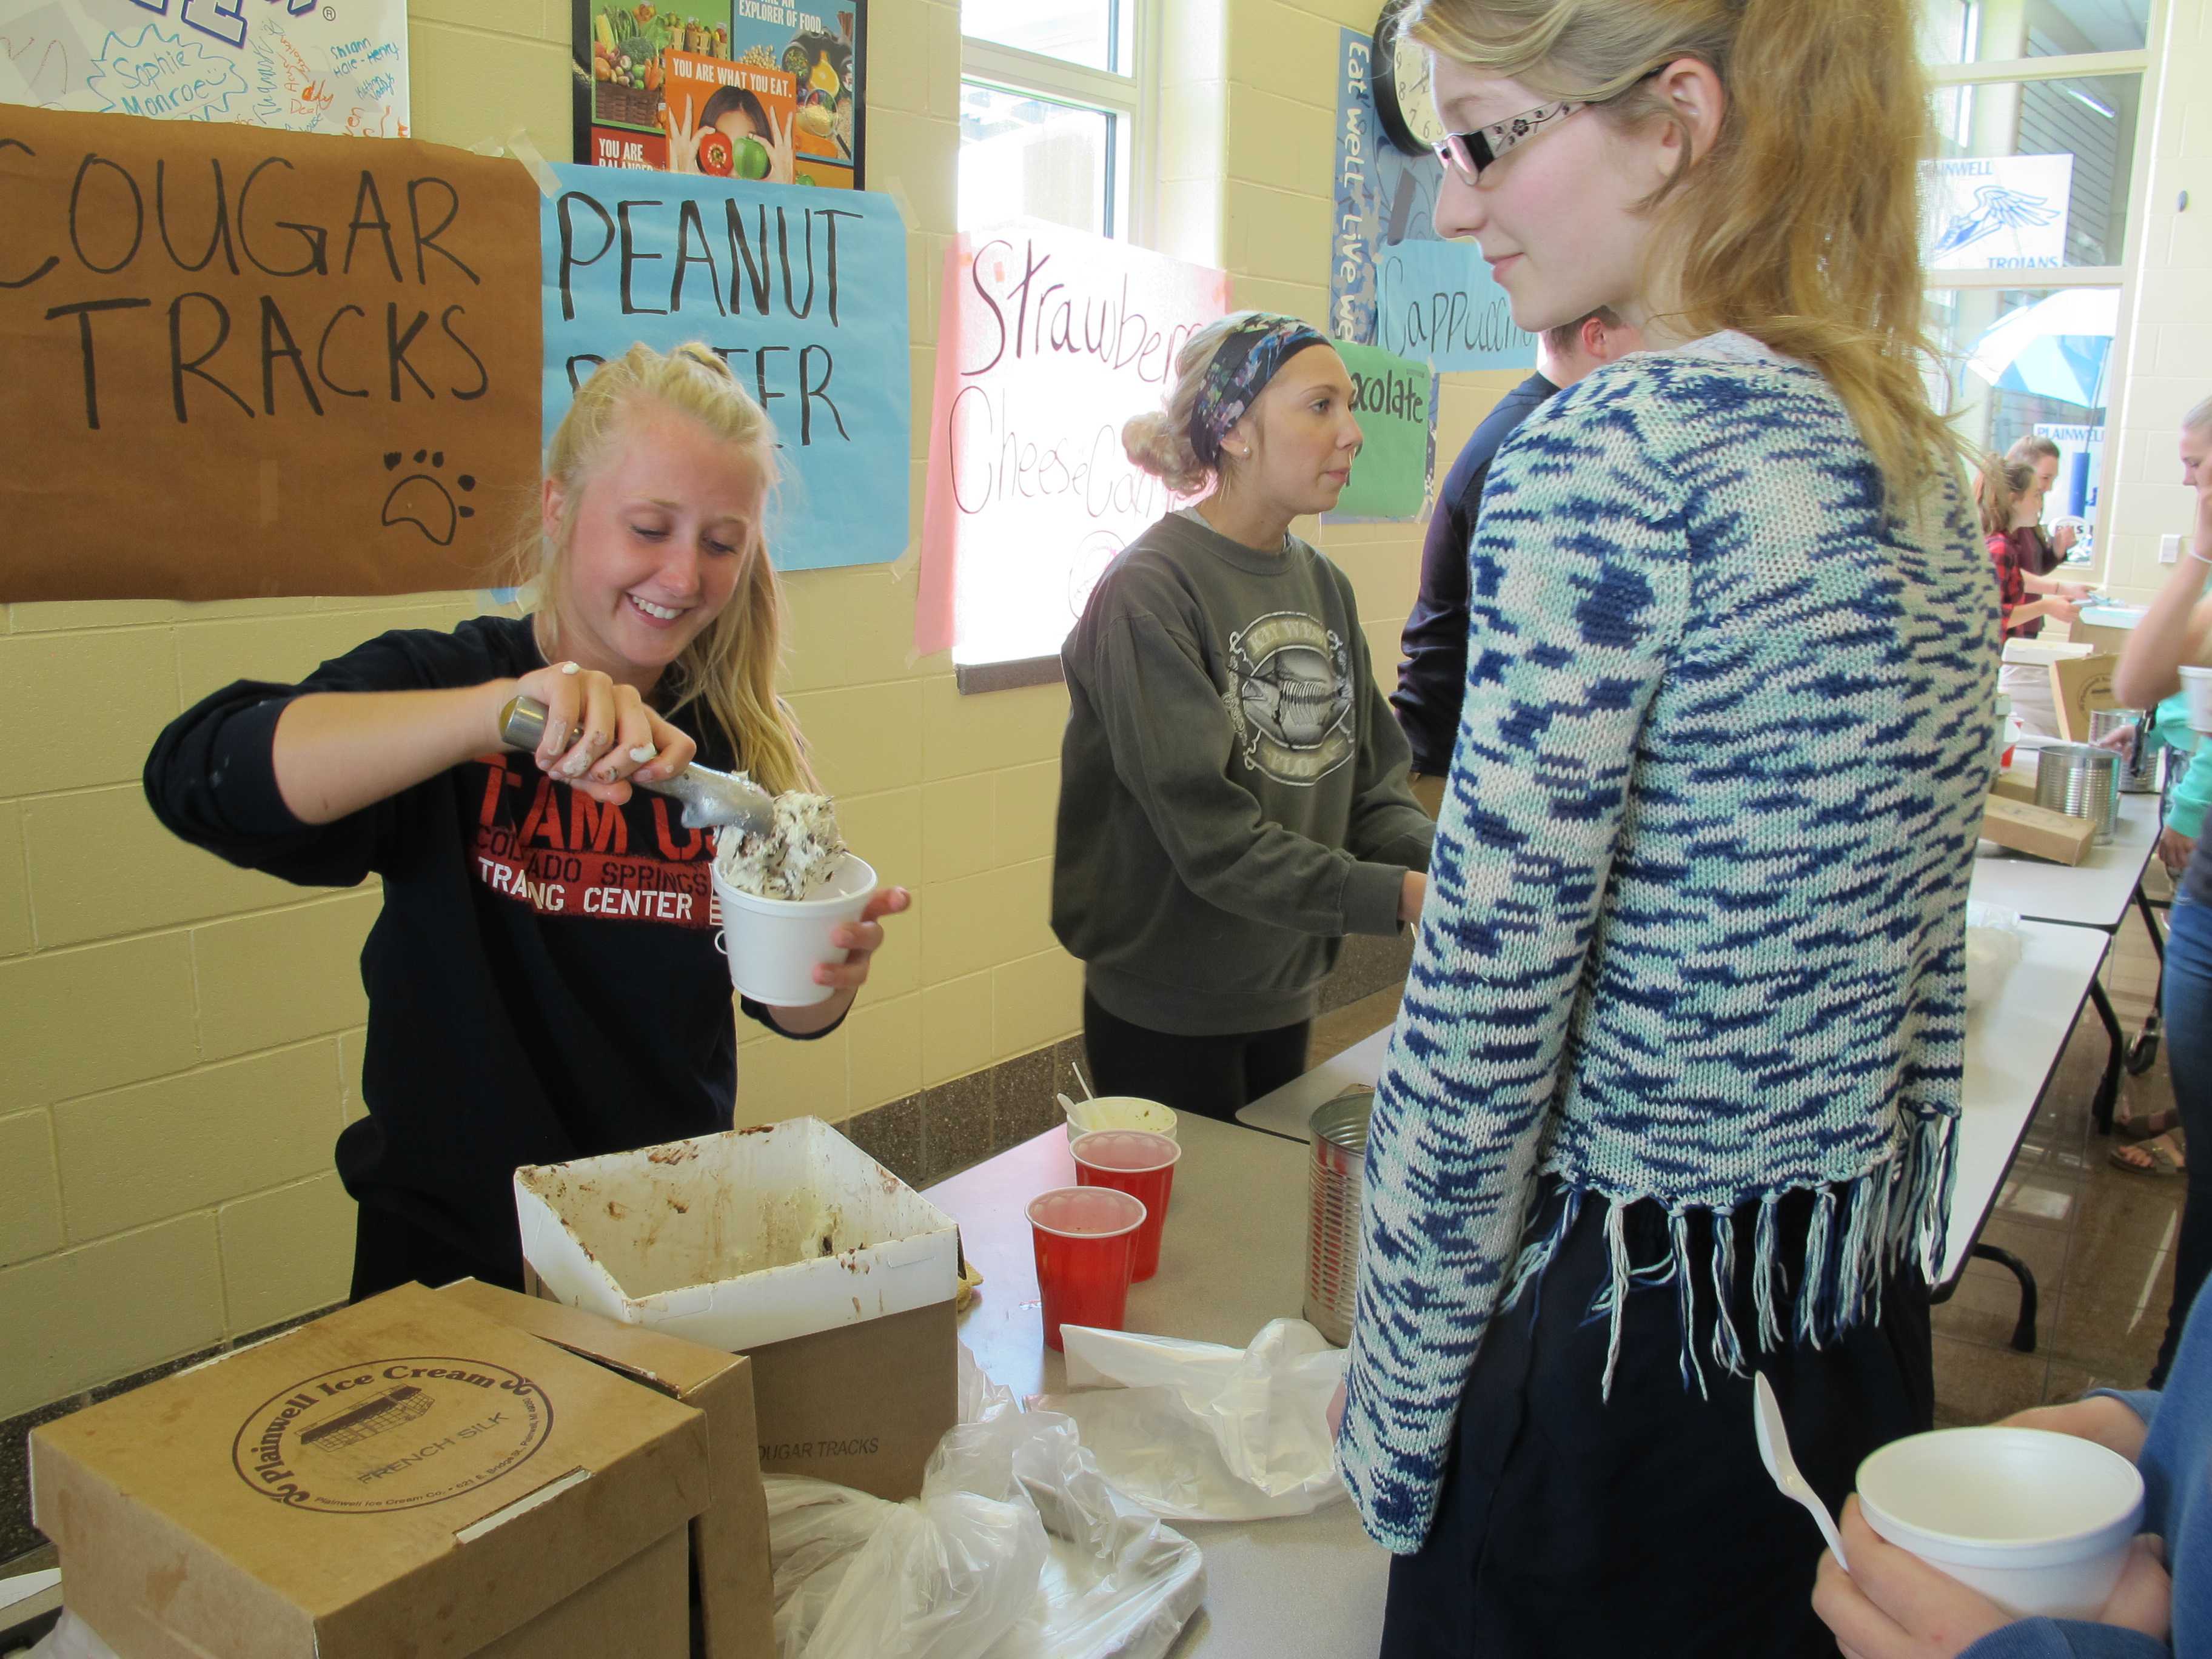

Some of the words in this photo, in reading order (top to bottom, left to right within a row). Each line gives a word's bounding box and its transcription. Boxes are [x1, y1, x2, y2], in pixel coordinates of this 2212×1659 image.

[739, 1, 784, 25] EXPLORER
[786, 8, 797, 28] OF
[800, 13, 824, 35] FOOD.
[113, 51, 191, 91] Sophie
[673, 58, 692, 78] YOU
[695, 63, 715, 82] ARE
[717, 67, 747, 90] WHAT
[749, 73, 768, 93] YOU
[771, 77, 792, 98] EAT.
[1349, 42, 1369, 94] Eat
[121, 79, 209, 116] Monroe
[598, 138, 620, 158] YOU
[623, 142, 643, 162] ARE
[557, 191, 863, 327] PEANUT
[45, 292, 488, 429] TRACKS
[601, 862, 709, 897] SPRINGS
[583, 887, 692, 920] CENTER
[251, 1393, 320, 1483] Plainwell
[316, 1375, 375, 1396] Ice
[383, 1366, 495, 1389] Cream
[357, 1438, 456, 1484] FRENCH
[457, 1412, 509, 1439] SILK
[758, 1442, 813, 1461] OUGAR
[818, 1437, 879, 1457] TRACKS
[315, 1496, 361, 1507] Plainwell
[386, 1495, 423, 1505] Cream
